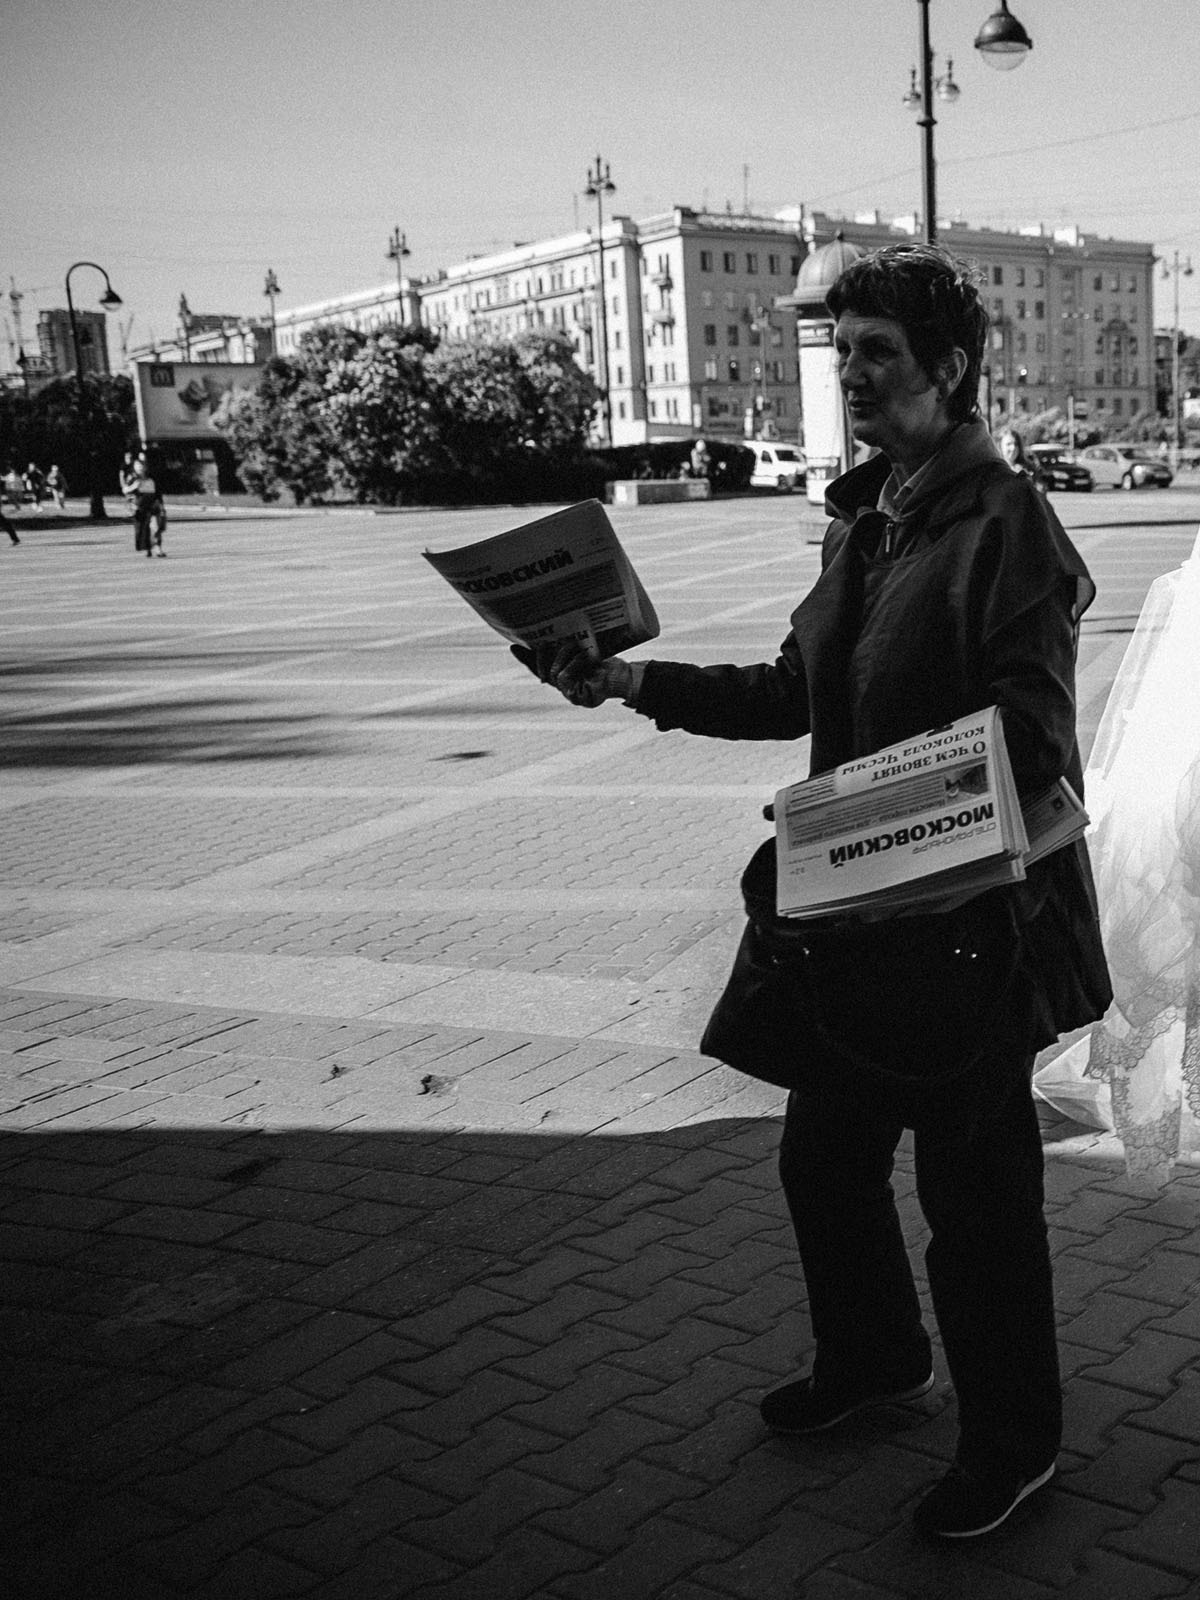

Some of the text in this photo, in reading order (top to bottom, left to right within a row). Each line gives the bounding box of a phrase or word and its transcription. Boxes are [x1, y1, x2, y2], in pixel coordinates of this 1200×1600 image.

[843, 726, 985, 776] колокола Чесмы
[872, 741, 986, 782] О чем звонят
[829, 802, 994, 868] МОСКОВСКИЙ
